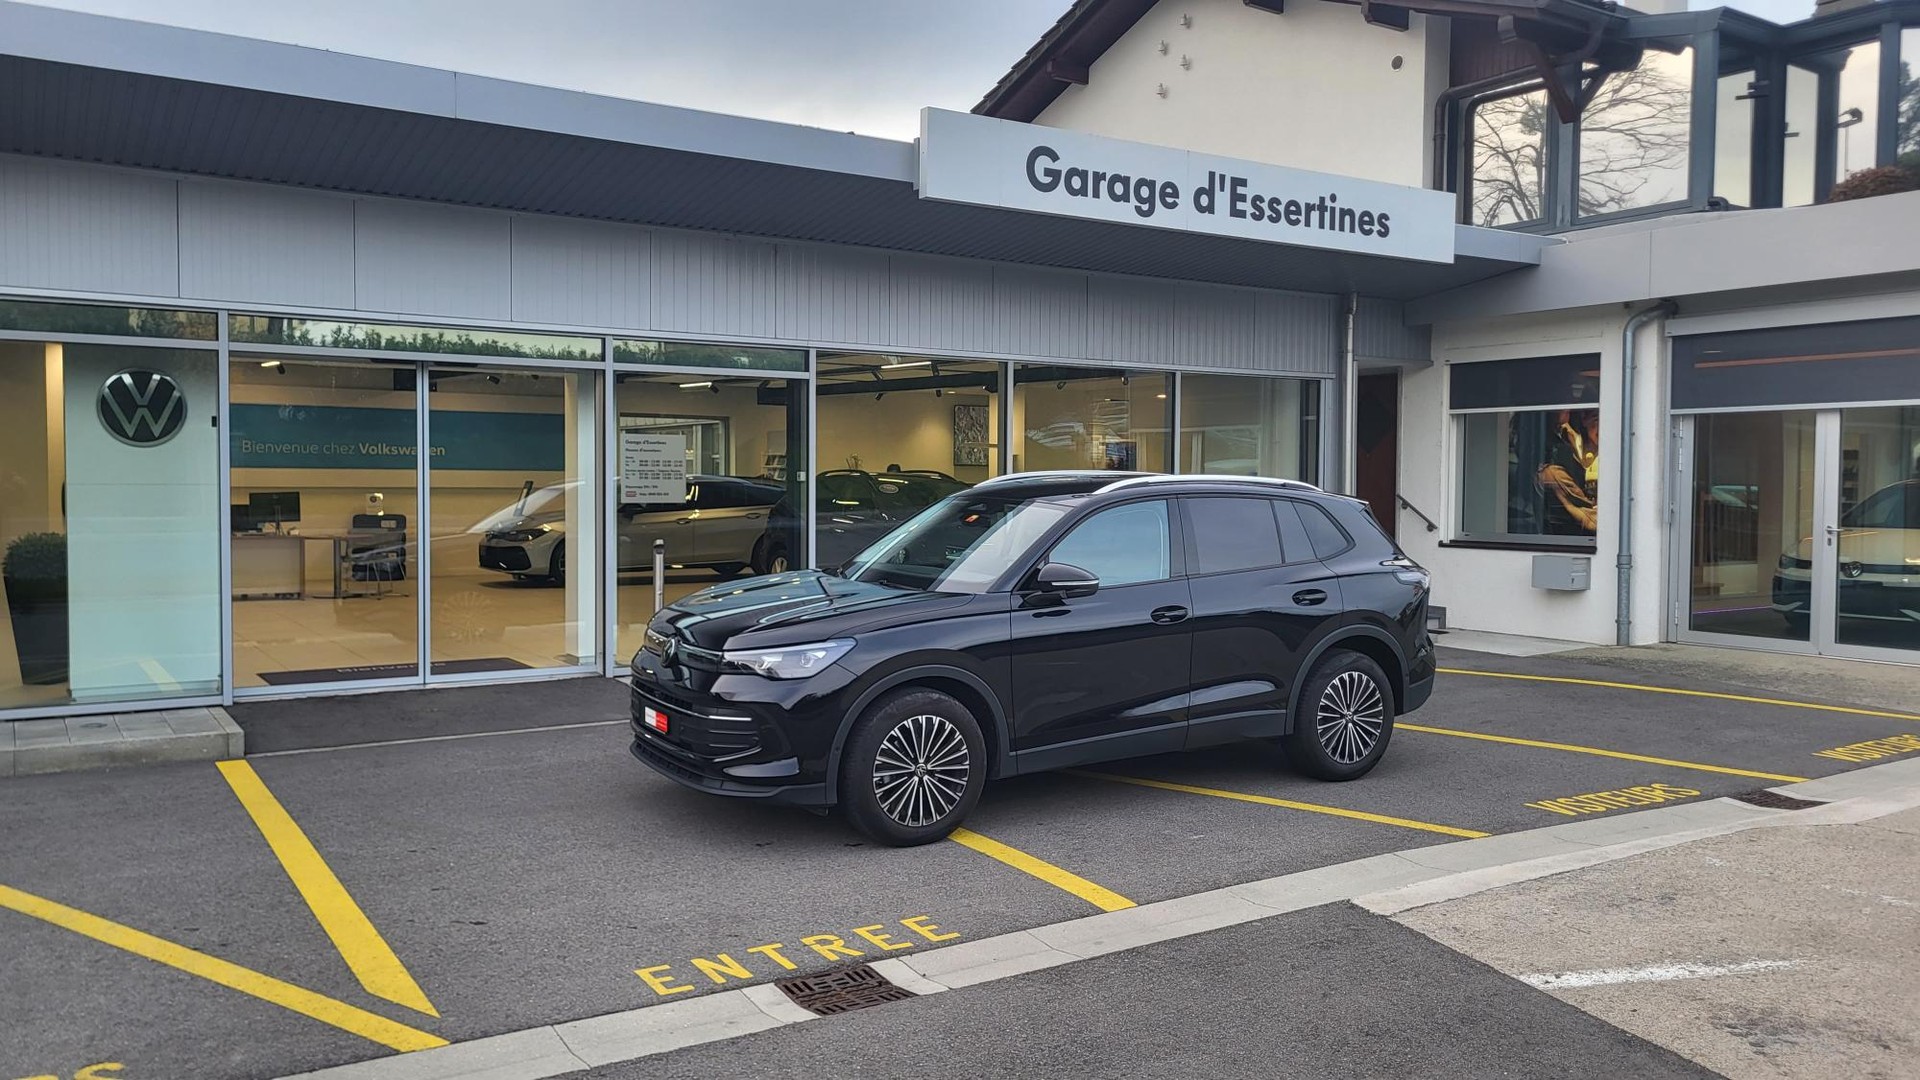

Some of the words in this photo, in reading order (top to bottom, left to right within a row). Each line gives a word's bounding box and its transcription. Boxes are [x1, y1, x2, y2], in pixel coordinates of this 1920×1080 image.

[1026, 145, 1179, 218] Garage
[1193, 171, 1391, 238] d'Essertines
[101, 372, 182, 439] VW
[241, 440, 319, 454] Bienvenue
[323, 442, 355, 454] chez
[359, 443, 446, 456] Volkswaen
[1522, 783, 1701, 817] VISITEURS
[634, 915, 961, 997] ENTREE
